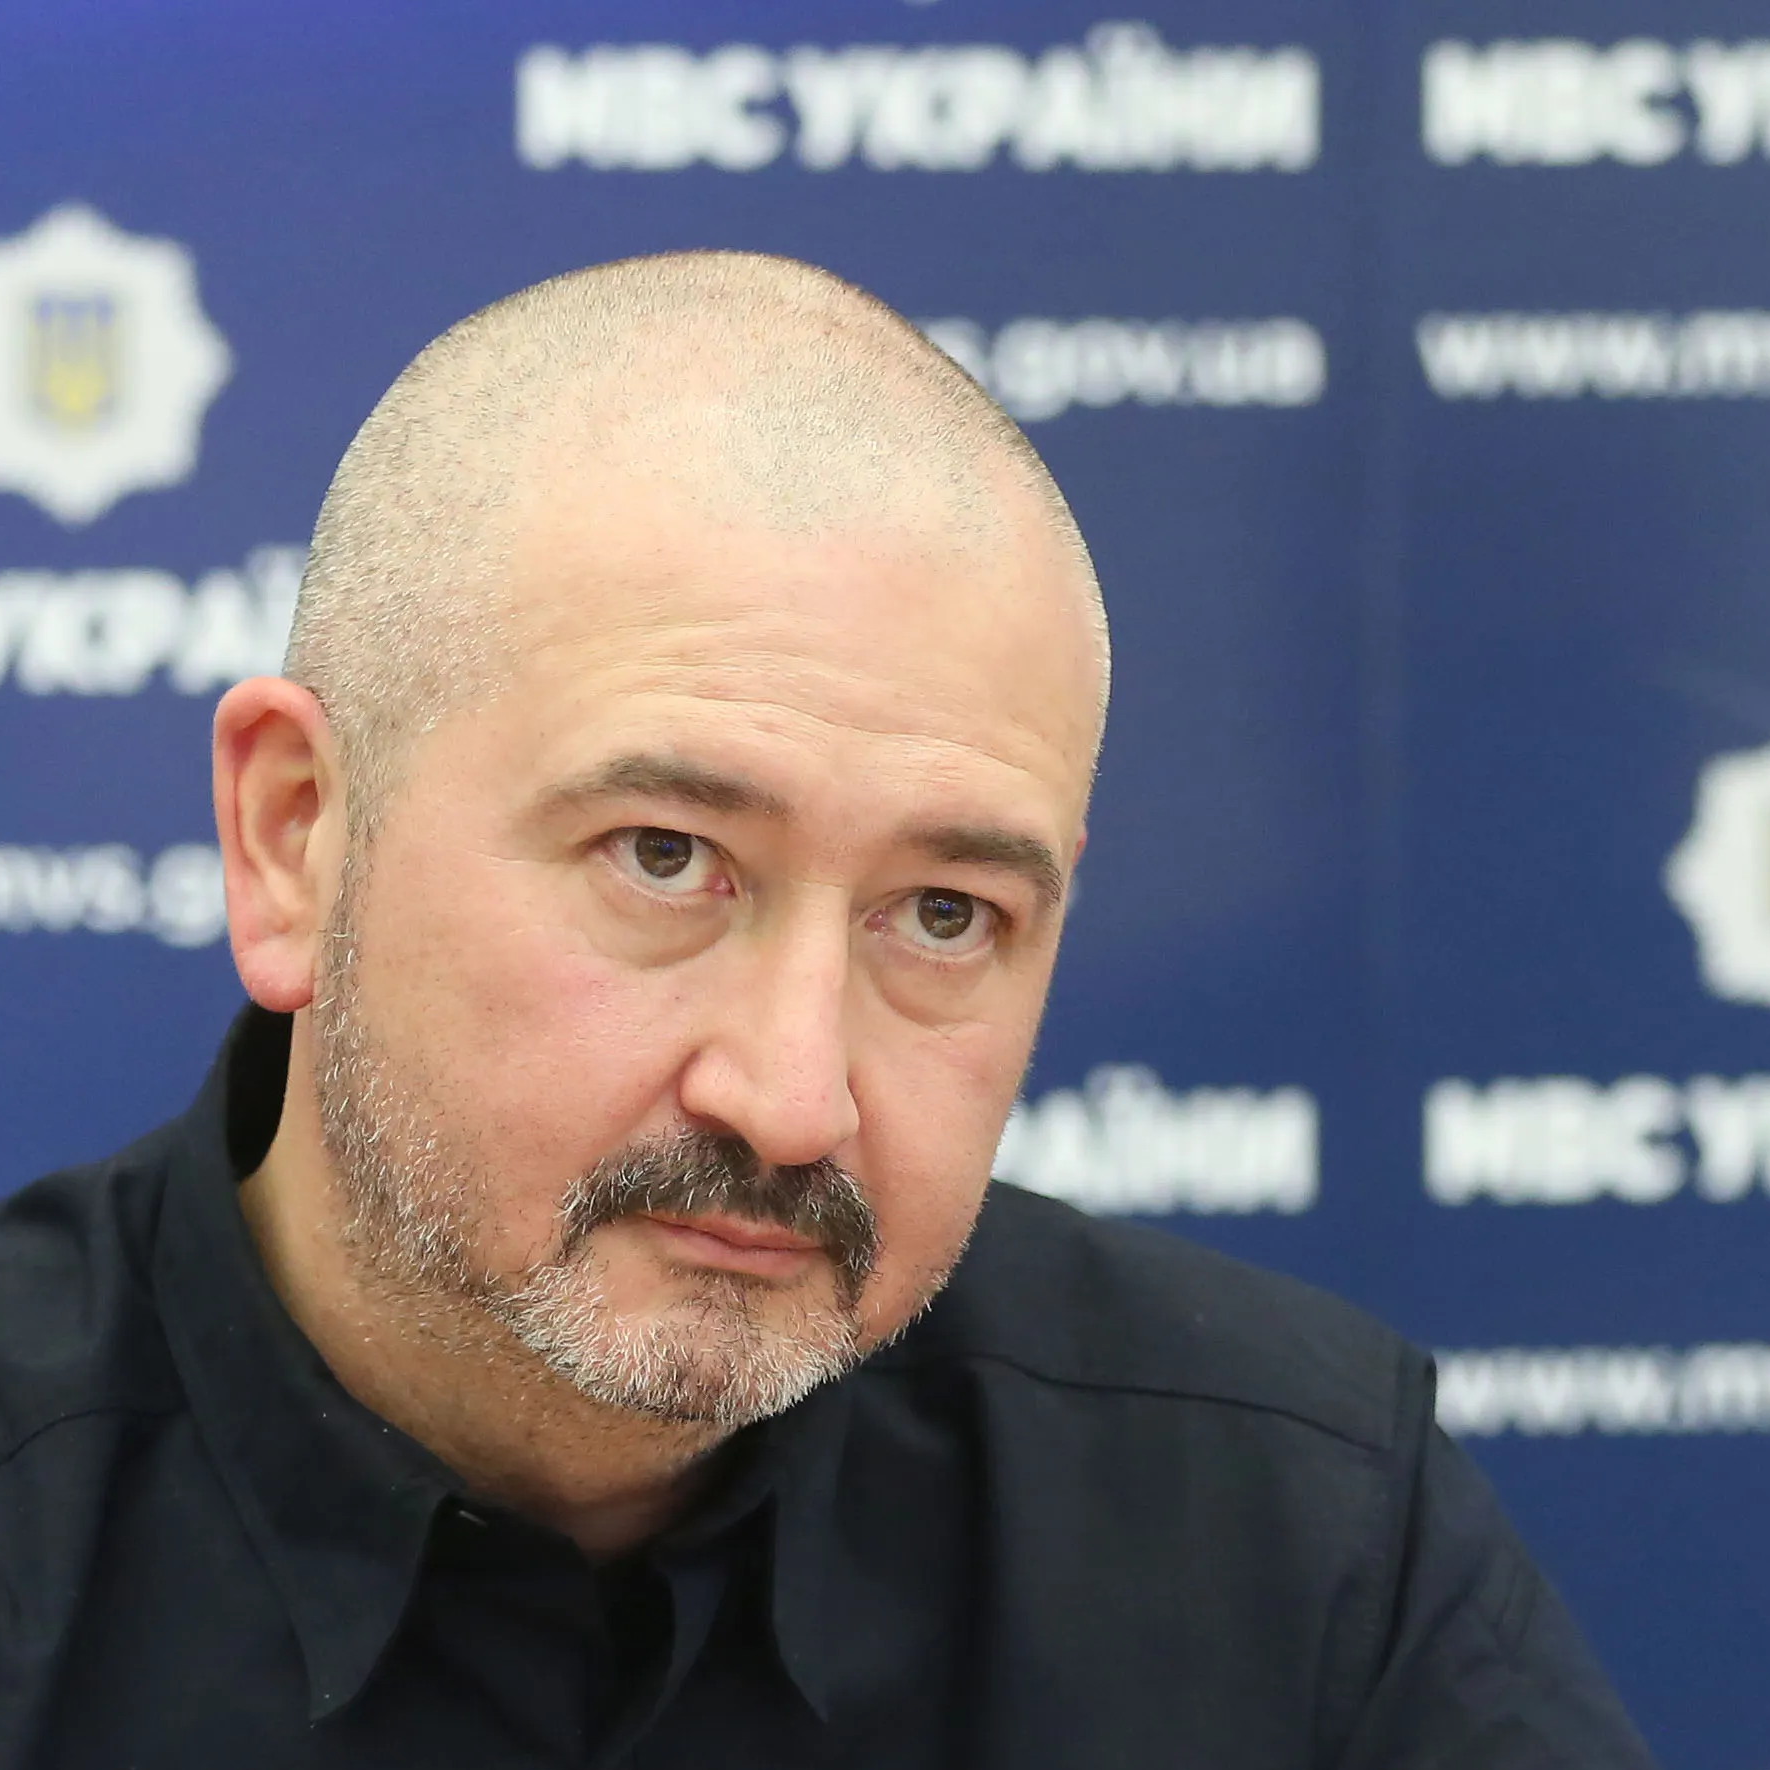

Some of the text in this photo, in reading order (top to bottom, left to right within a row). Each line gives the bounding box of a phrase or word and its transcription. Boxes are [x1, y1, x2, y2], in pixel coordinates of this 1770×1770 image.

[516, 25, 1319, 170] МВС УКРАЇНИ
[1423, 40, 1685, 164] МВС
[1424, 1077, 1686, 1203] МВС
